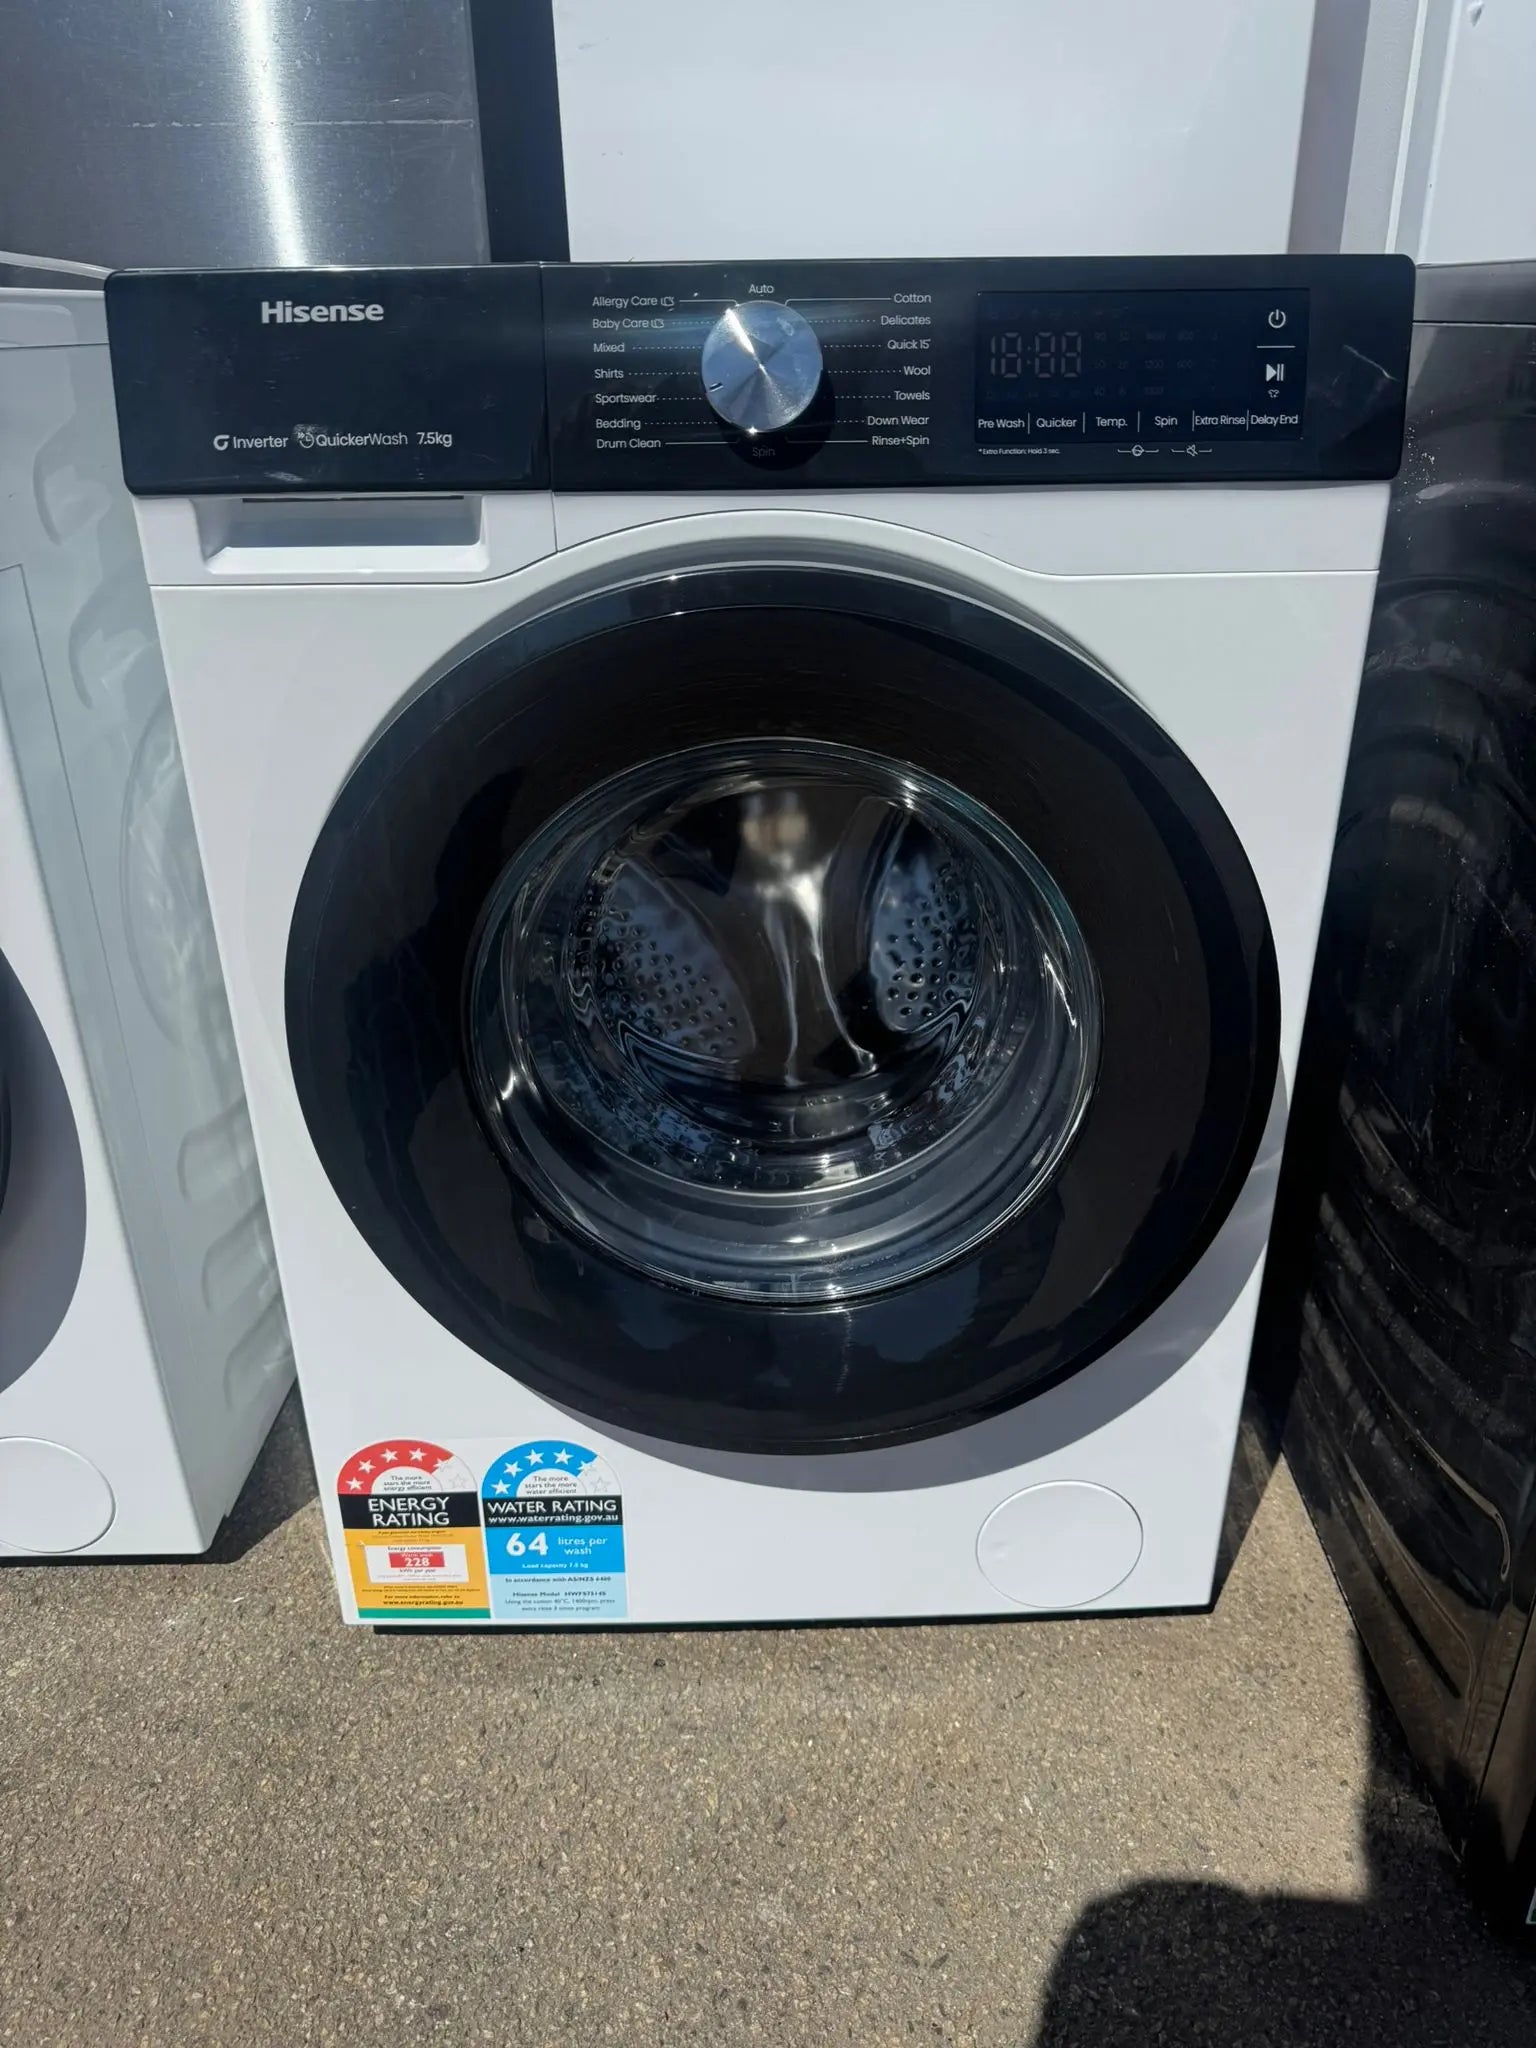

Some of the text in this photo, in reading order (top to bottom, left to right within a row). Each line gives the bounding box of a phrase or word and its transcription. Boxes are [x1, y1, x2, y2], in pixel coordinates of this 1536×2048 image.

[748, 284, 775, 294] Auto
[592, 296, 658, 308] Allergy Care
[893, 293, 932, 304] Cotton
[261, 300, 385, 324] Hisense
[592, 318, 649, 331] Baby Care
[880, 315, 931, 326] Delicates
[593, 342, 626, 352] Mixed
[887, 339, 918, 350] Quick
[594, 368, 625, 379] Shirts
[903, 365, 932, 376] Wool
[595, 394, 657, 404] Sportswear
[894, 390, 930, 400] Towels
[596, 419, 642, 430] Bedding
[867, 416, 930, 426] Down Wear
[977, 418, 1025, 428] Pre Wash
[1036, 417, 1078, 428] Quicker
[1095, 416, 1128, 429] Temp.
[1154, 415, 1178, 428] Spin
[1195, 415, 1246, 426] Extra Rinse
[1251, 414, 1299, 427] Delay End
[233, 436, 289, 450] Inverter
[315, 431, 454, 448] QuickerWash 7.5kg
[596, 438, 662, 450] Drum Clean
[872, 435, 930, 448] Rinse+Spin
[752, 446, 776, 458] Spin
[367, 1496, 450, 1512] ENERGY
[487, 1500, 617, 1514] WATER RATING
[372, 1512, 450, 1528] RATING
[488, 1513, 619, 1525] www.waterrating.gov.au
[506, 1532, 549, 1556] 64
[558, 1536, 608, 1548] litres per
[564, 1547, 592, 1556] wash
[405, 1557, 431, 1568] 228
